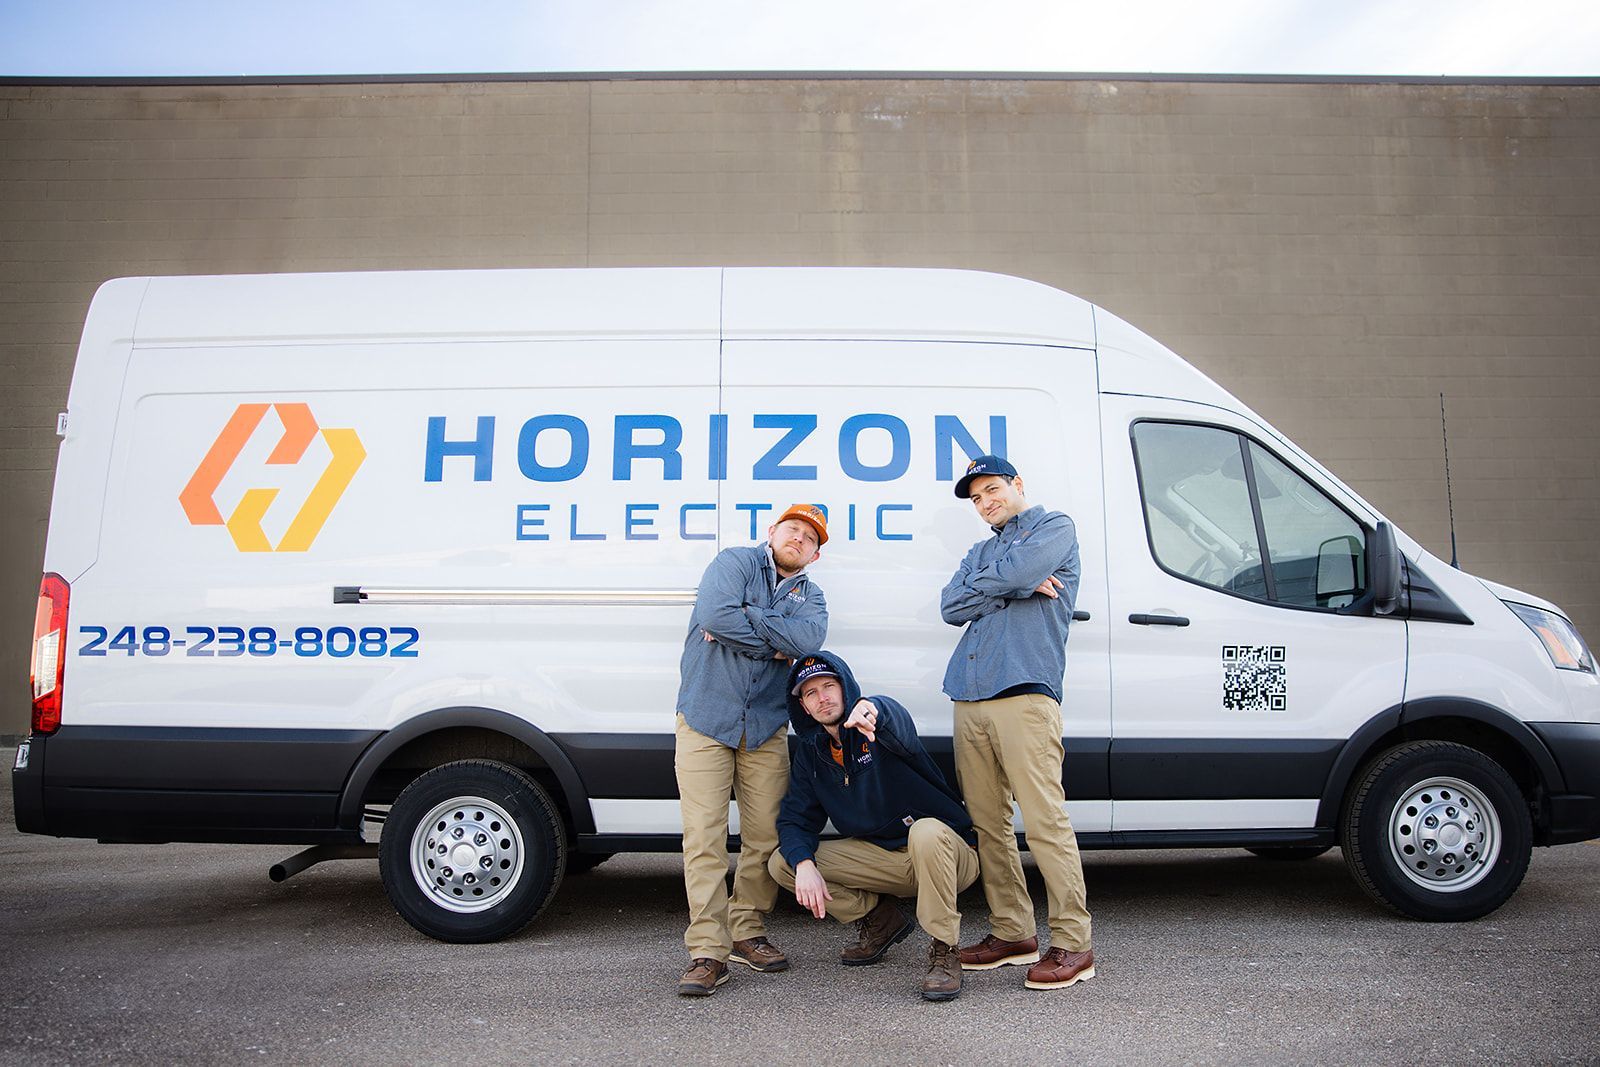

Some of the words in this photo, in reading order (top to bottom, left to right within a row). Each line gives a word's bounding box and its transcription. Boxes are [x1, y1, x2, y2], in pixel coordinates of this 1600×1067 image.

[424, 413, 1007, 482] HORIZON
[516, 503, 913, 541] ELECTIC
[78, 626, 420, 658] 248-238-8082
[798, 664, 827, 677] HORIZON
